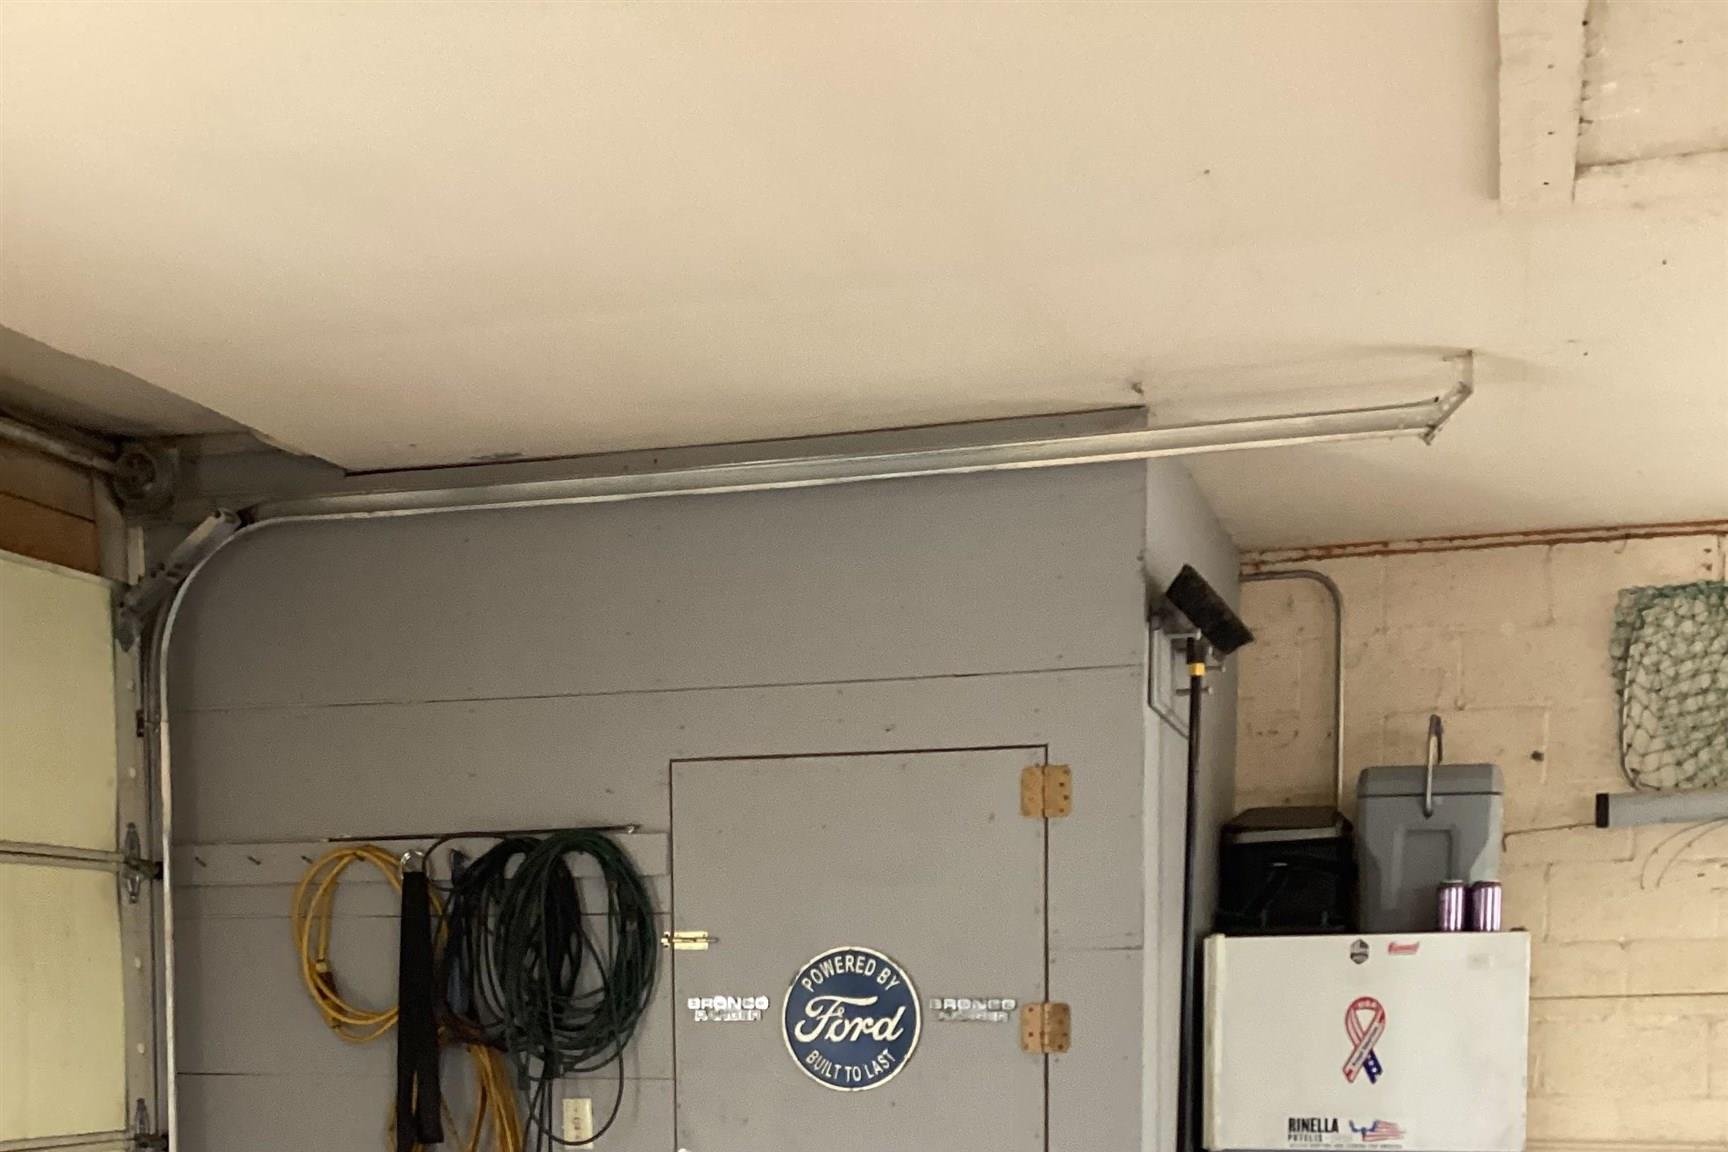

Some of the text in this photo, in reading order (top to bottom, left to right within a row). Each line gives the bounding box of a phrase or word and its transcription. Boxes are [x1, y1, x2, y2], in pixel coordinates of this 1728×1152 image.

[802, 954, 900, 992] POWERED BY
[687, 996, 769, 1010] BRONCO
[794, 995, 906, 1042] Ford
[806, 1048, 896, 1083] BUILT TO LAST
[1288, 1118, 1339, 1133] RINELLA
